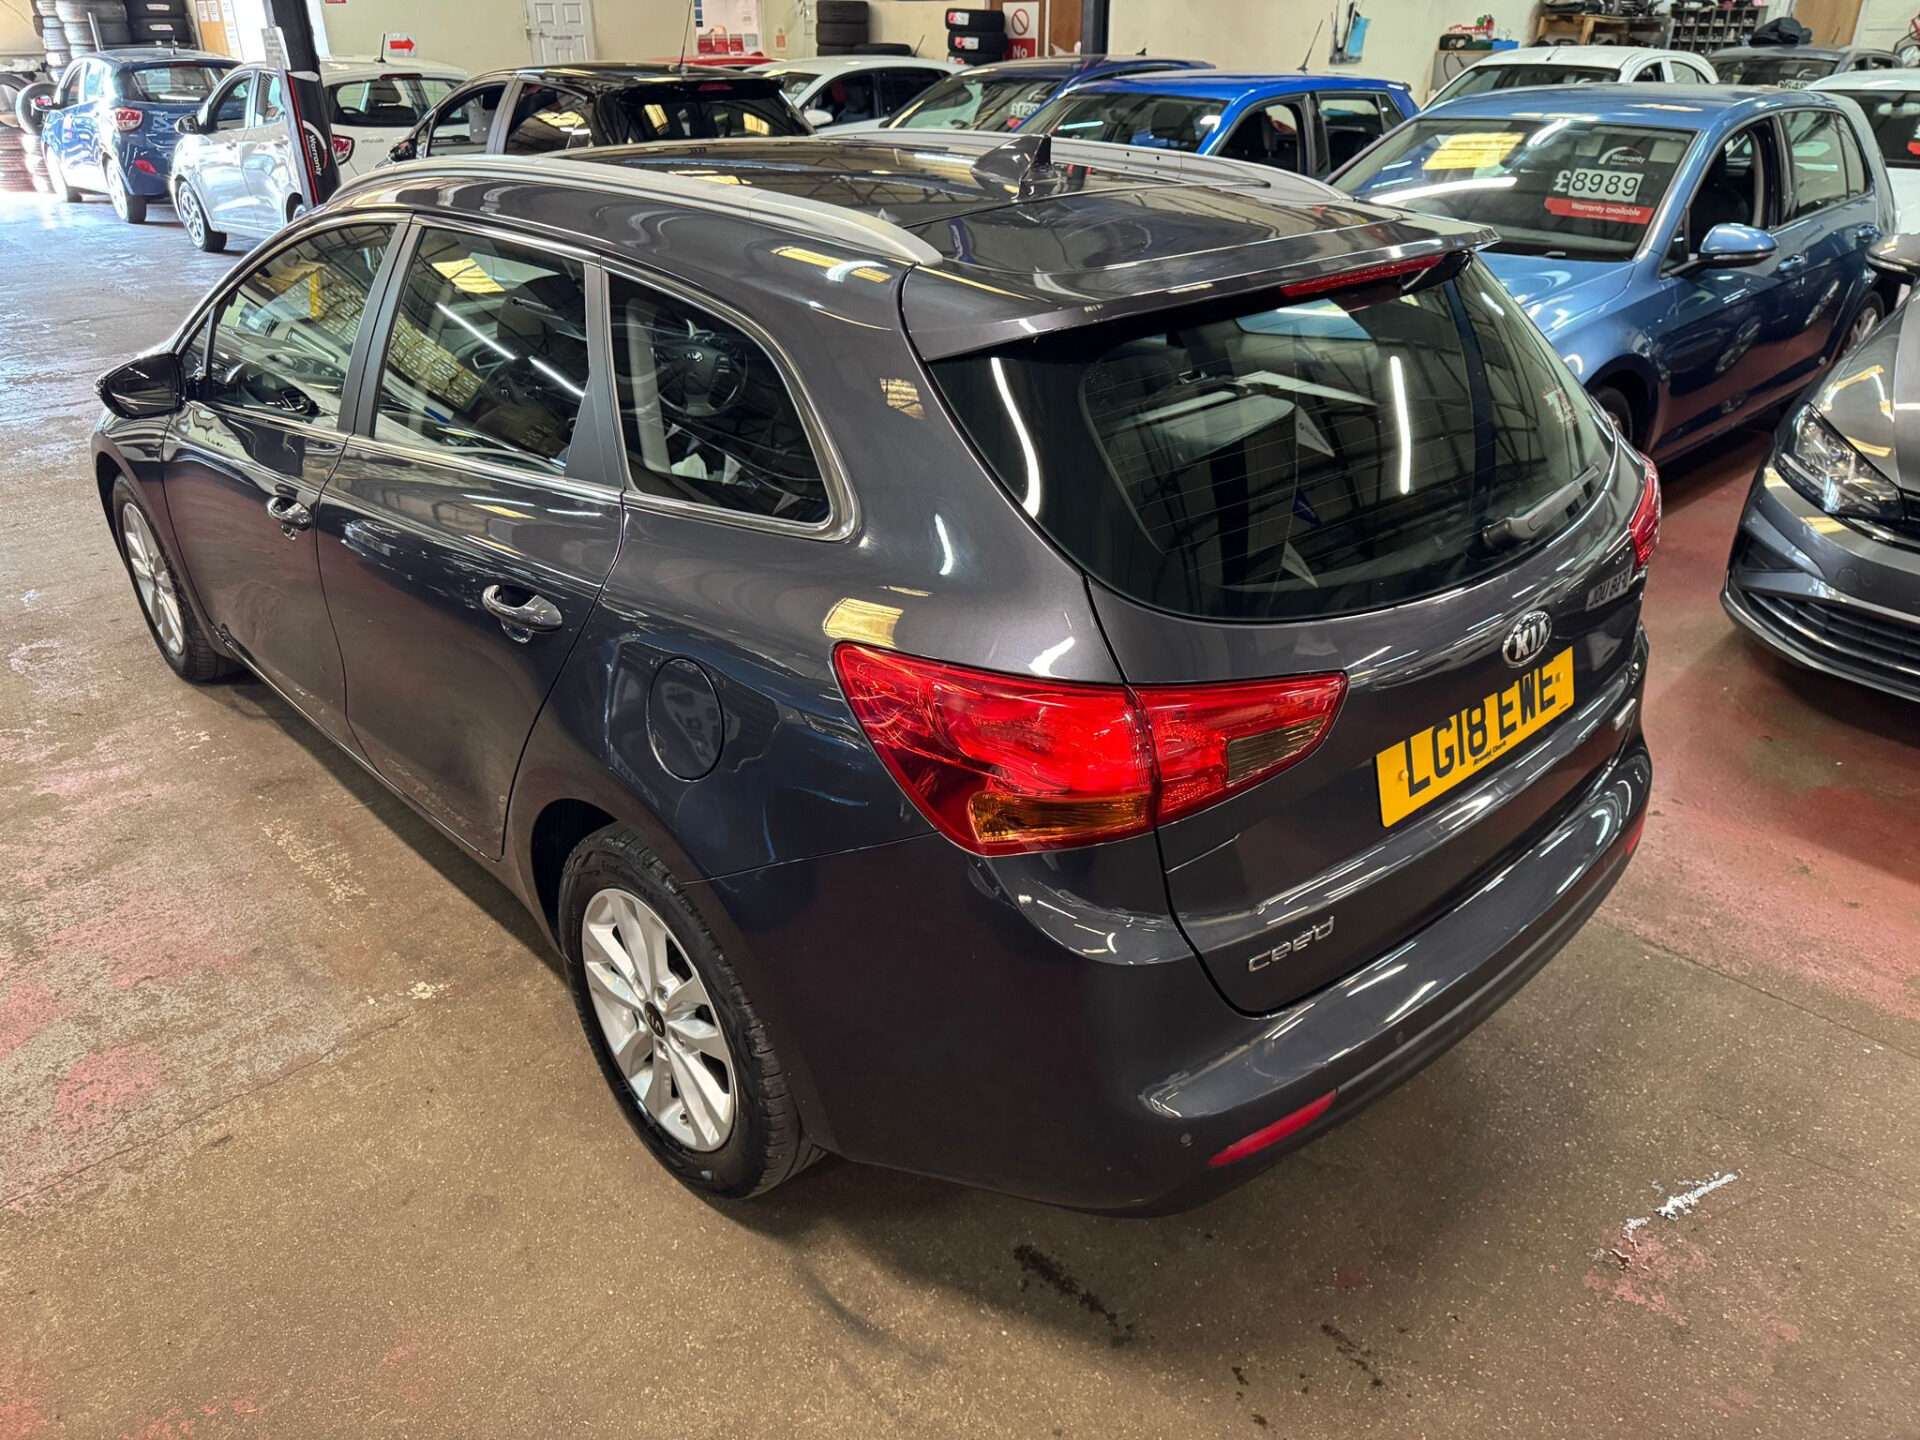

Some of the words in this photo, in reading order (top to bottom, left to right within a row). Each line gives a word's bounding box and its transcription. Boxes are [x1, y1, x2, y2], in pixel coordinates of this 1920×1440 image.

[1013, 45, 1028, 58] No
[1553, 169, 1639, 198] £8989
[1514, 616, 1548, 660] KIA
[1404, 704, 1488, 797] LG18
[1497, 657, 1556, 740] EWE
